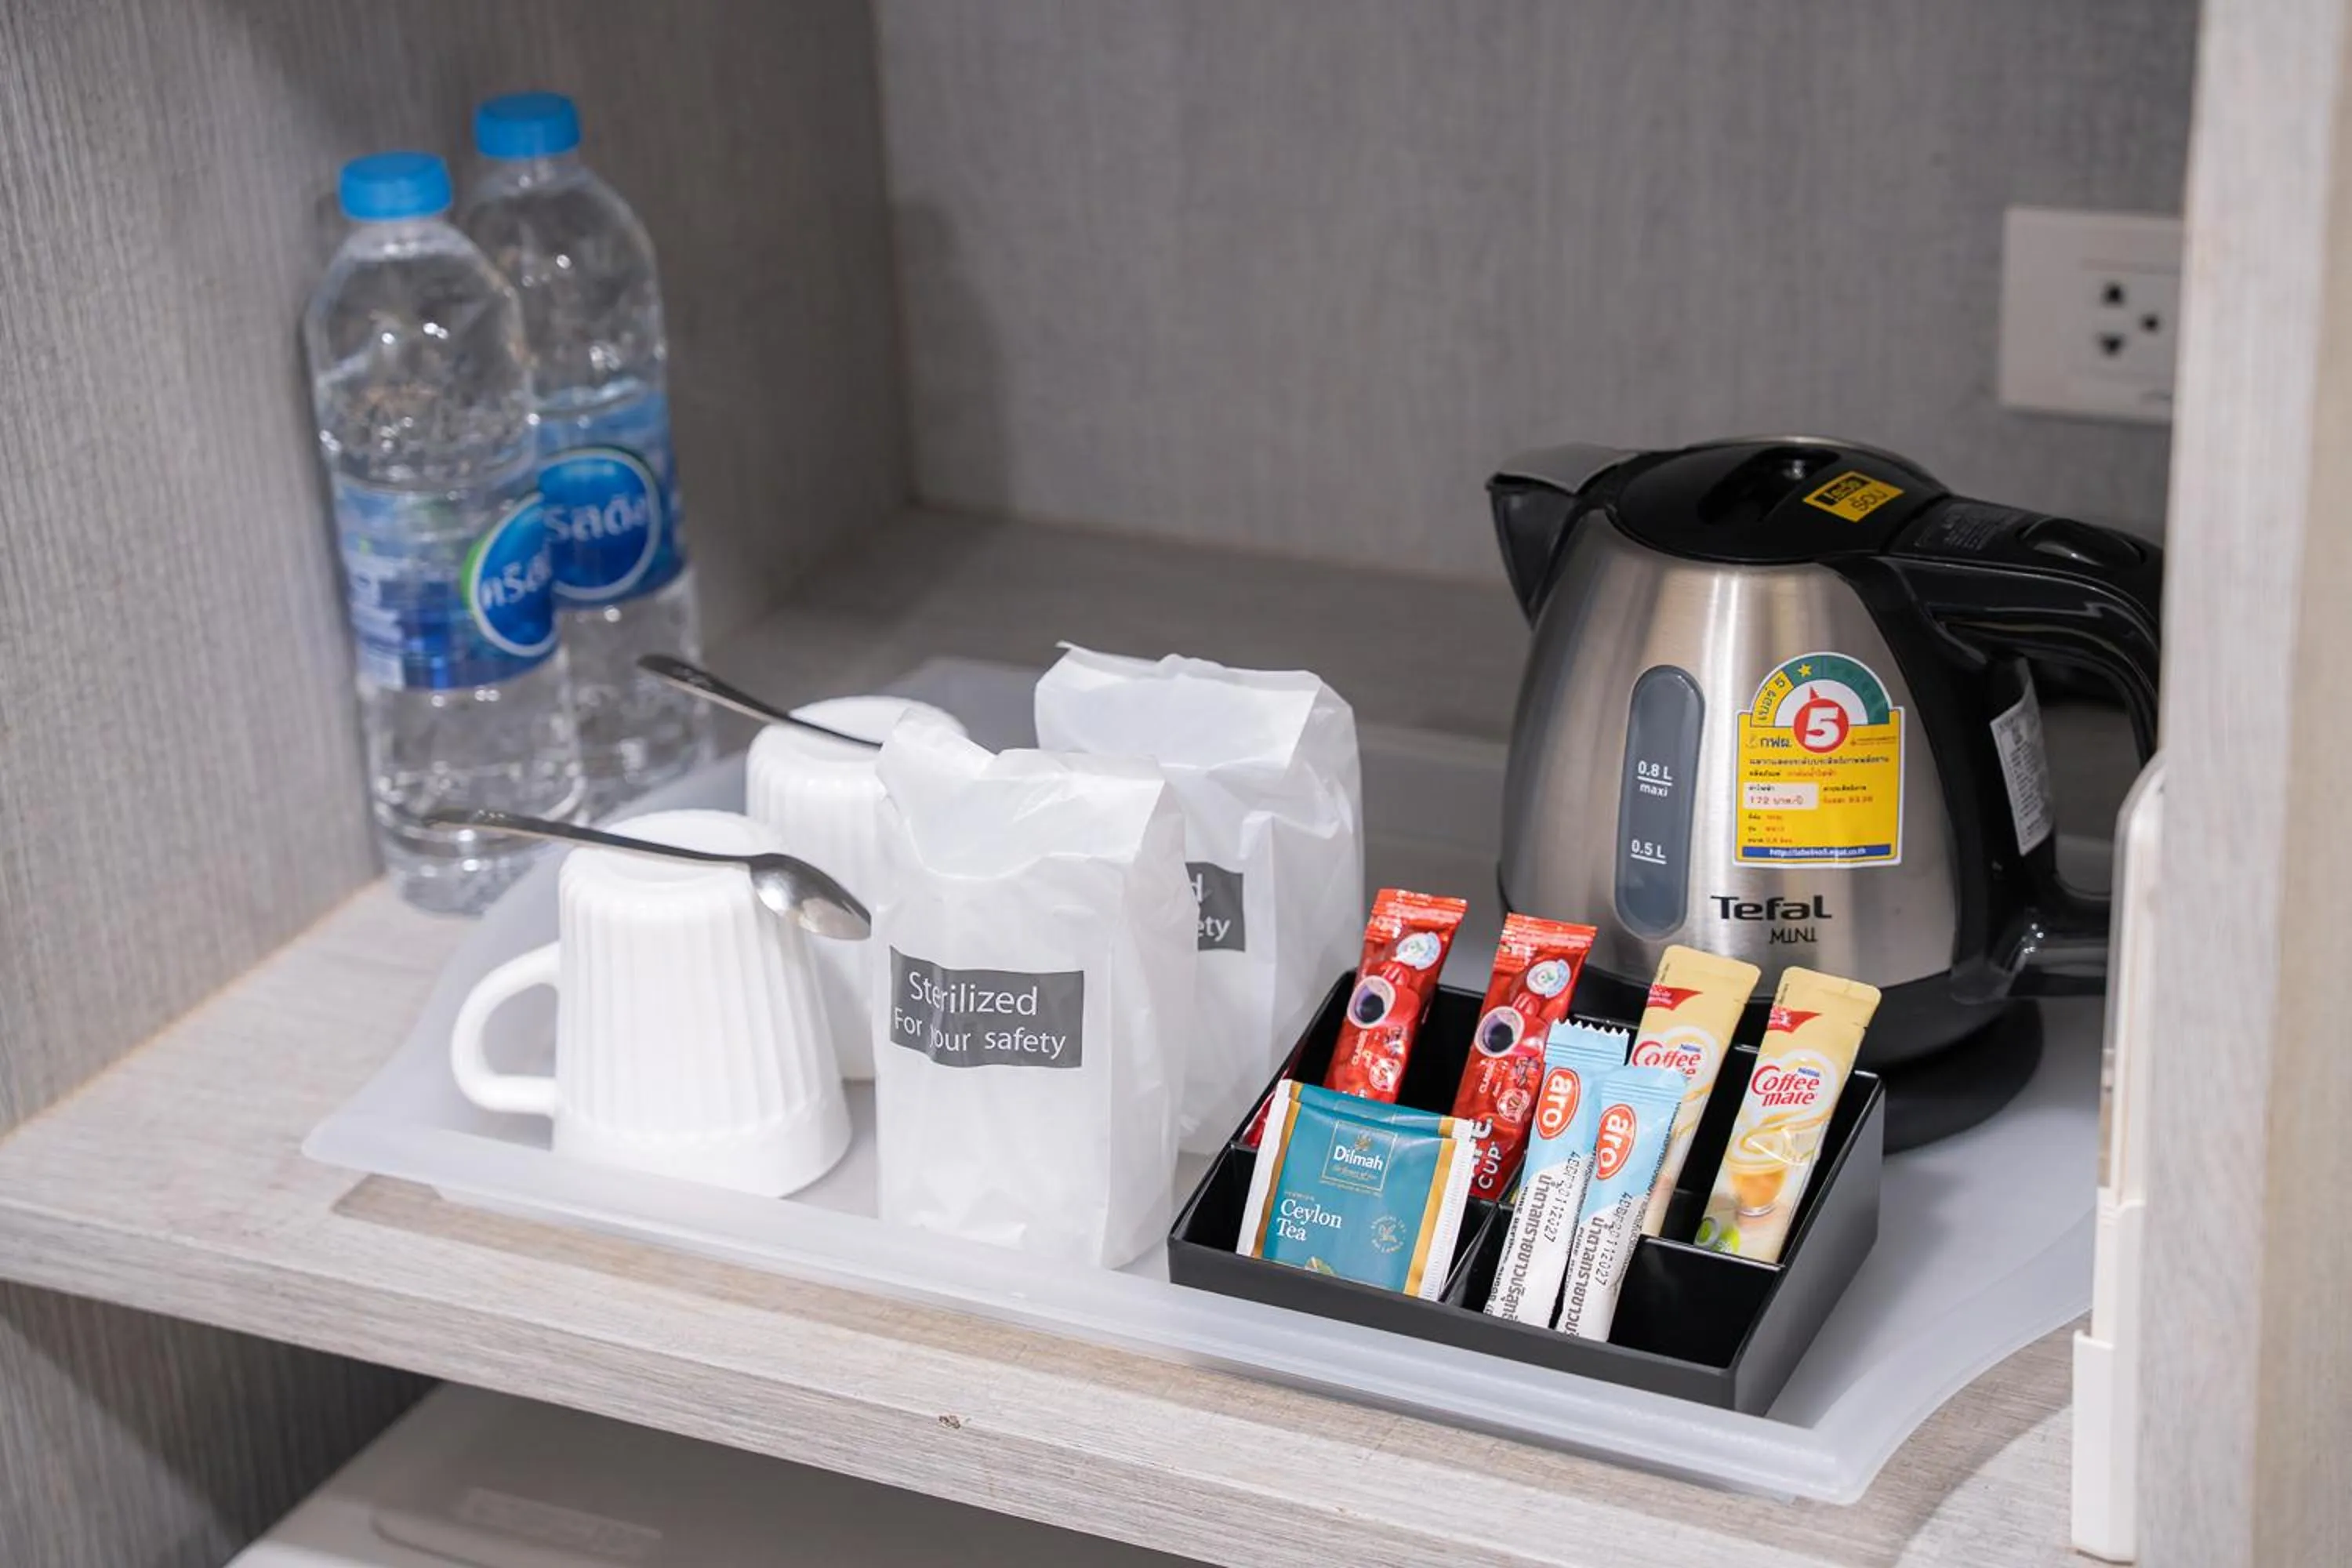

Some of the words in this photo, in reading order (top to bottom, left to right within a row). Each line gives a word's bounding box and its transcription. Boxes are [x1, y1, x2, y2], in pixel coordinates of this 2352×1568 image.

[1774, 677, 1785, 688] 5
[1804, 707, 1840, 747] 5
[1638, 760, 1660, 778] 0.8
[1662, 766, 1671, 780] L
[1640, 782, 1668, 797] maxi
[1632, 840, 1653, 856] 0.5
[1657, 845, 1666, 859] L
[1711, 895, 1833, 920] Tefal
[1197, 916, 1231, 942] ety
[1769, 927, 1817, 945] MINI
[909, 971, 1038, 1015] Sterilized
[894, 1007, 923, 1037] For
[984, 1026, 1066, 1059] safety
[1751, 1065, 1820, 1095] Coffee
[1542, 1075, 1573, 1127] aro
[1762, 1091, 1816, 1107] mate
[1600, 1113, 1629, 1169] aro
[1334, 1145, 1384, 1171] Dilmah
[1478, 1145, 1502, 1190] CUP
[1280, 1198, 1343, 1229] Ceylon
[1276, 1218, 1307, 1242] Tea
